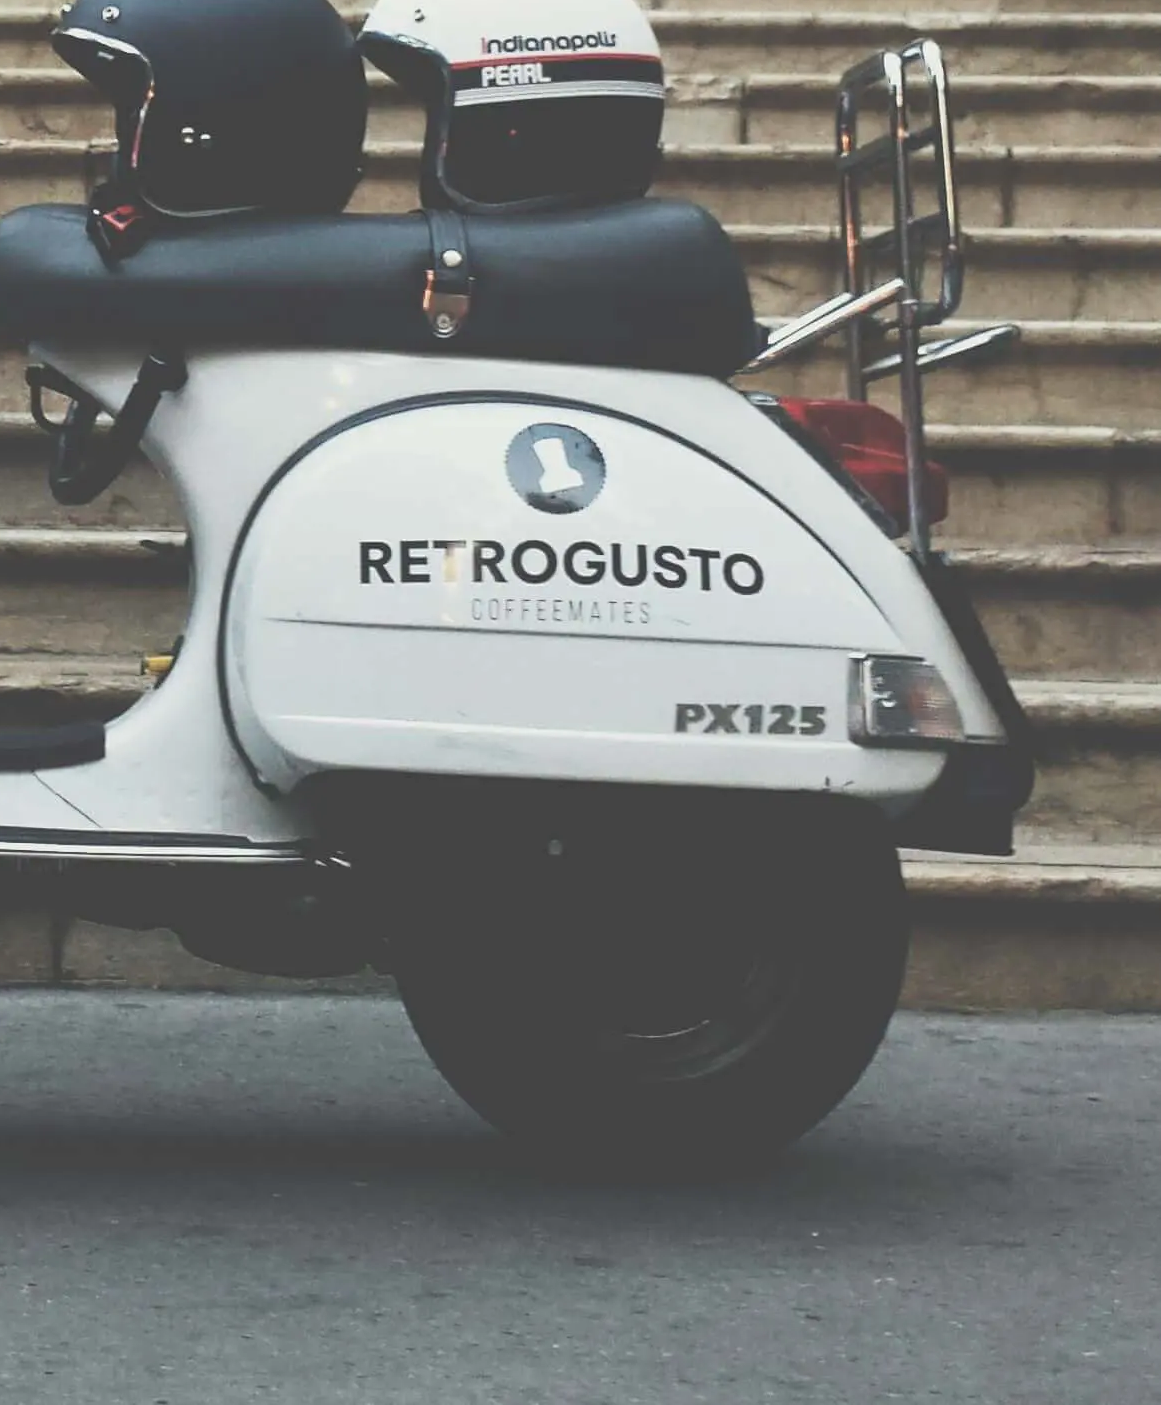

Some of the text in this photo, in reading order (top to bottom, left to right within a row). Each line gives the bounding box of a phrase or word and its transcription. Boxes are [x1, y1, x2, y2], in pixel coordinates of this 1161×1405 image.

[481, 62, 552, 88] PEARL
[360, 540, 765, 596] RETROGUSTO
[471, 598, 651, 624] COFFEEMATES
[675, 703, 826, 736] PX125
